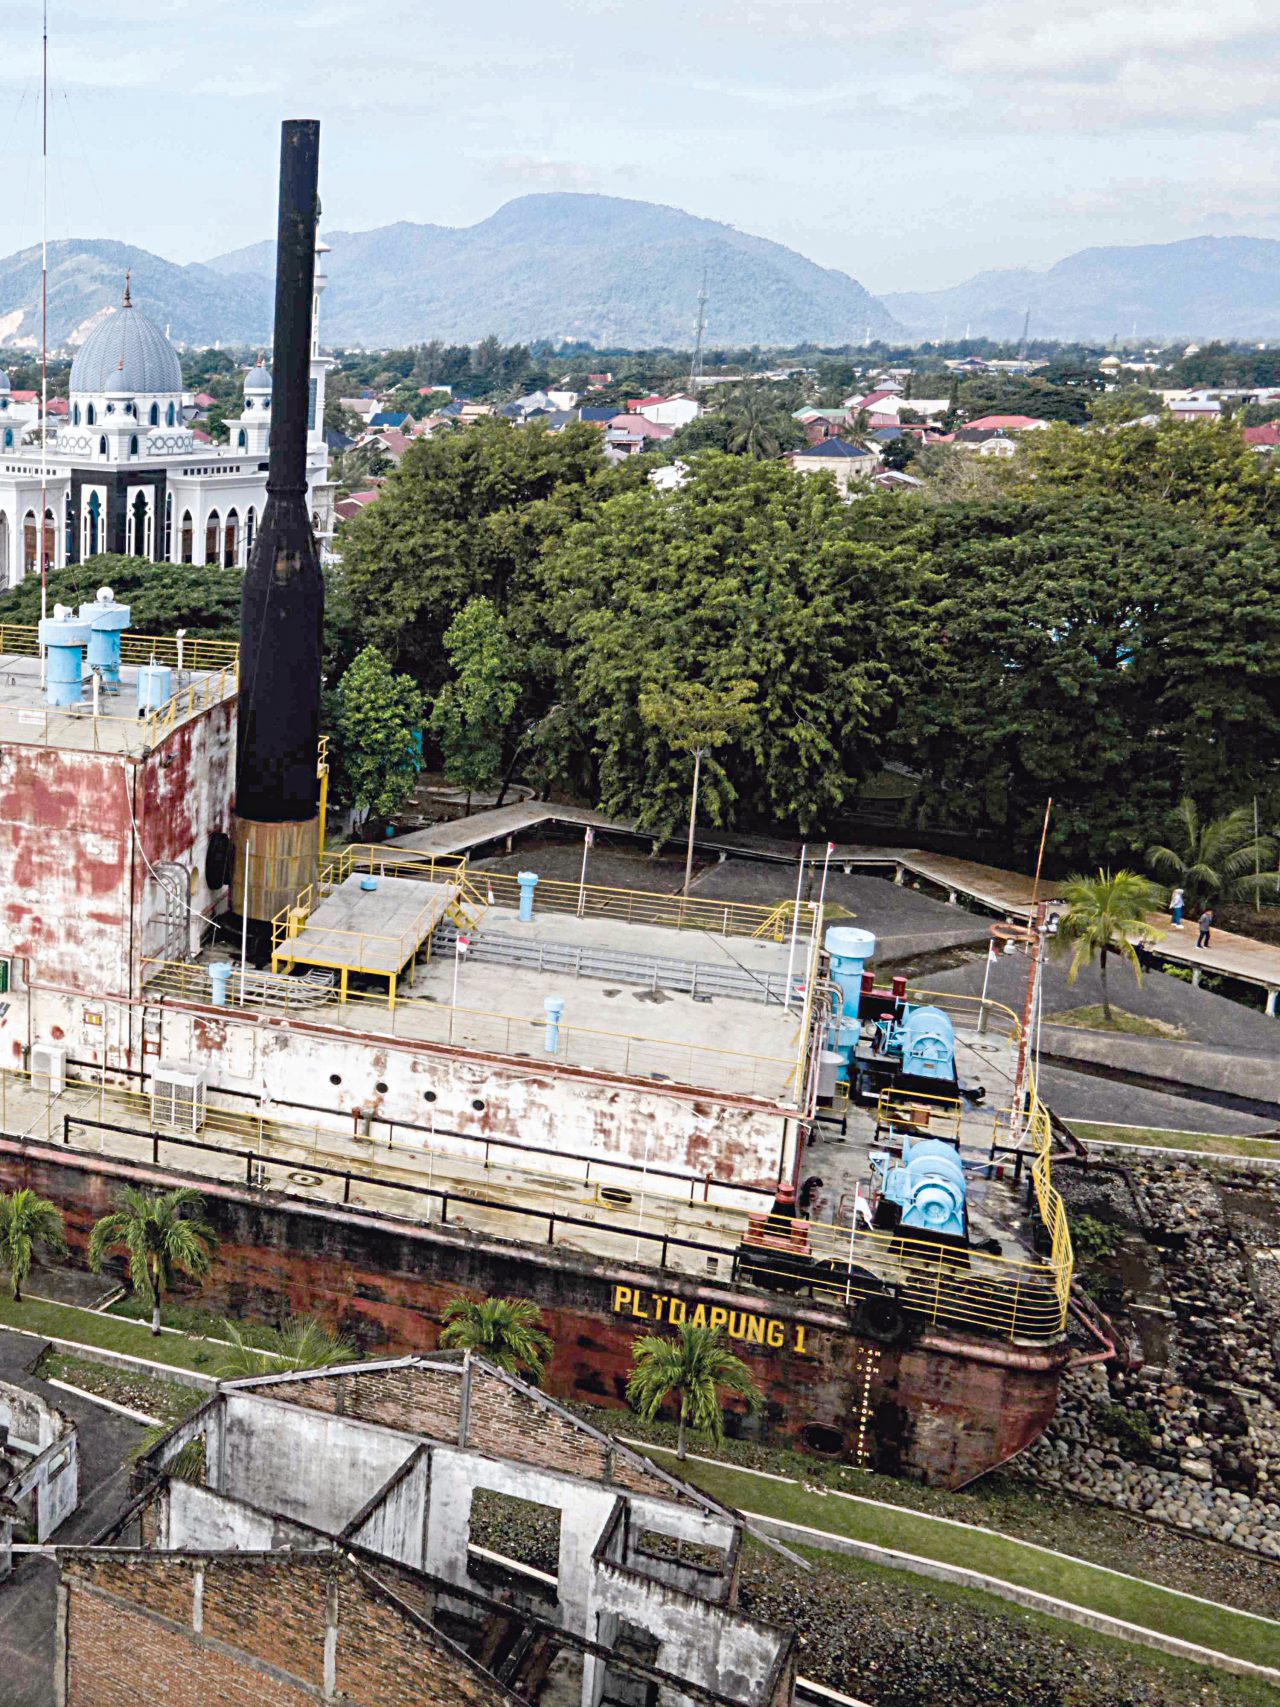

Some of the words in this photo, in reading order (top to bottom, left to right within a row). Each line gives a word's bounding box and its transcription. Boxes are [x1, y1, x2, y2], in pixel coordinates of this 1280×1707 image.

[613, 1285, 686, 1325] PLTD
[692, 1303, 784, 1348] APUNG
[793, 1324, 806, 1353] 1
